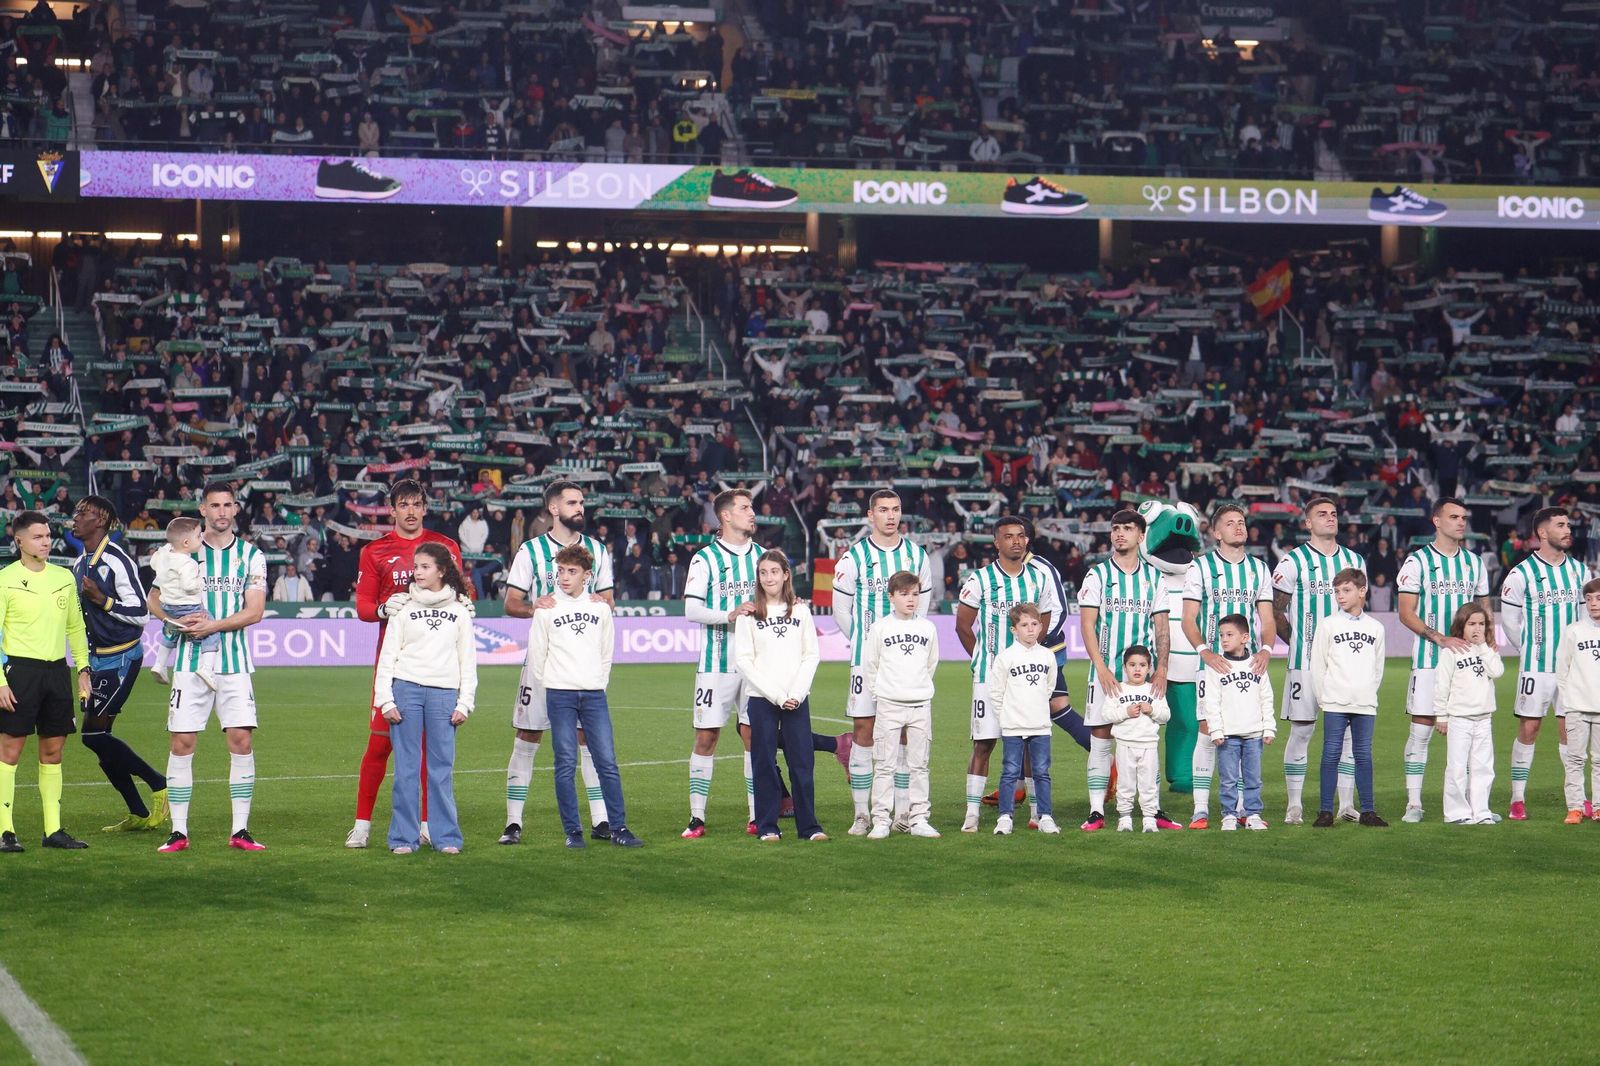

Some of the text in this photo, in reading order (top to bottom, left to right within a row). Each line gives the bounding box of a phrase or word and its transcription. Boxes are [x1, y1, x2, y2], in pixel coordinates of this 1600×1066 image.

[1201, 3, 1273, 19] Cruzcampo
[152, 163, 256, 190] ICONIC
[499, 168, 653, 201] SILBON
[853, 180, 948, 205] ICONIC
[1177, 185, 1318, 216] SILBON
[1498, 195, 1584, 220] ICONIC
[720, 580, 757, 591] BAHRA
[1431, 580, 1474, 590] BAHRAIN
[1106, 598, 1152, 608] BAHRAIN
[409, 609, 458, 623] SILBON
[553, 612, 600, 628] SILBON
[756, 616, 801, 630] SILBON
[253, 629, 346, 659] BON
[621, 628, 701, 653] ICONI
[884, 633, 929, 647] SILBON
[1333, 631, 1377, 645] SILBON
[1010, 663, 1050, 677] SILBON
[1220, 671, 1262, 686] SILBON
[1521, 676, 1535, 695] 10
[170, 687, 182, 709] 21
[519, 685, 532, 706] 15
[695, 687, 713, 708] 24
[1119, 694, 1154, 705] SILBON
[973, 699, 985, 719] 19
